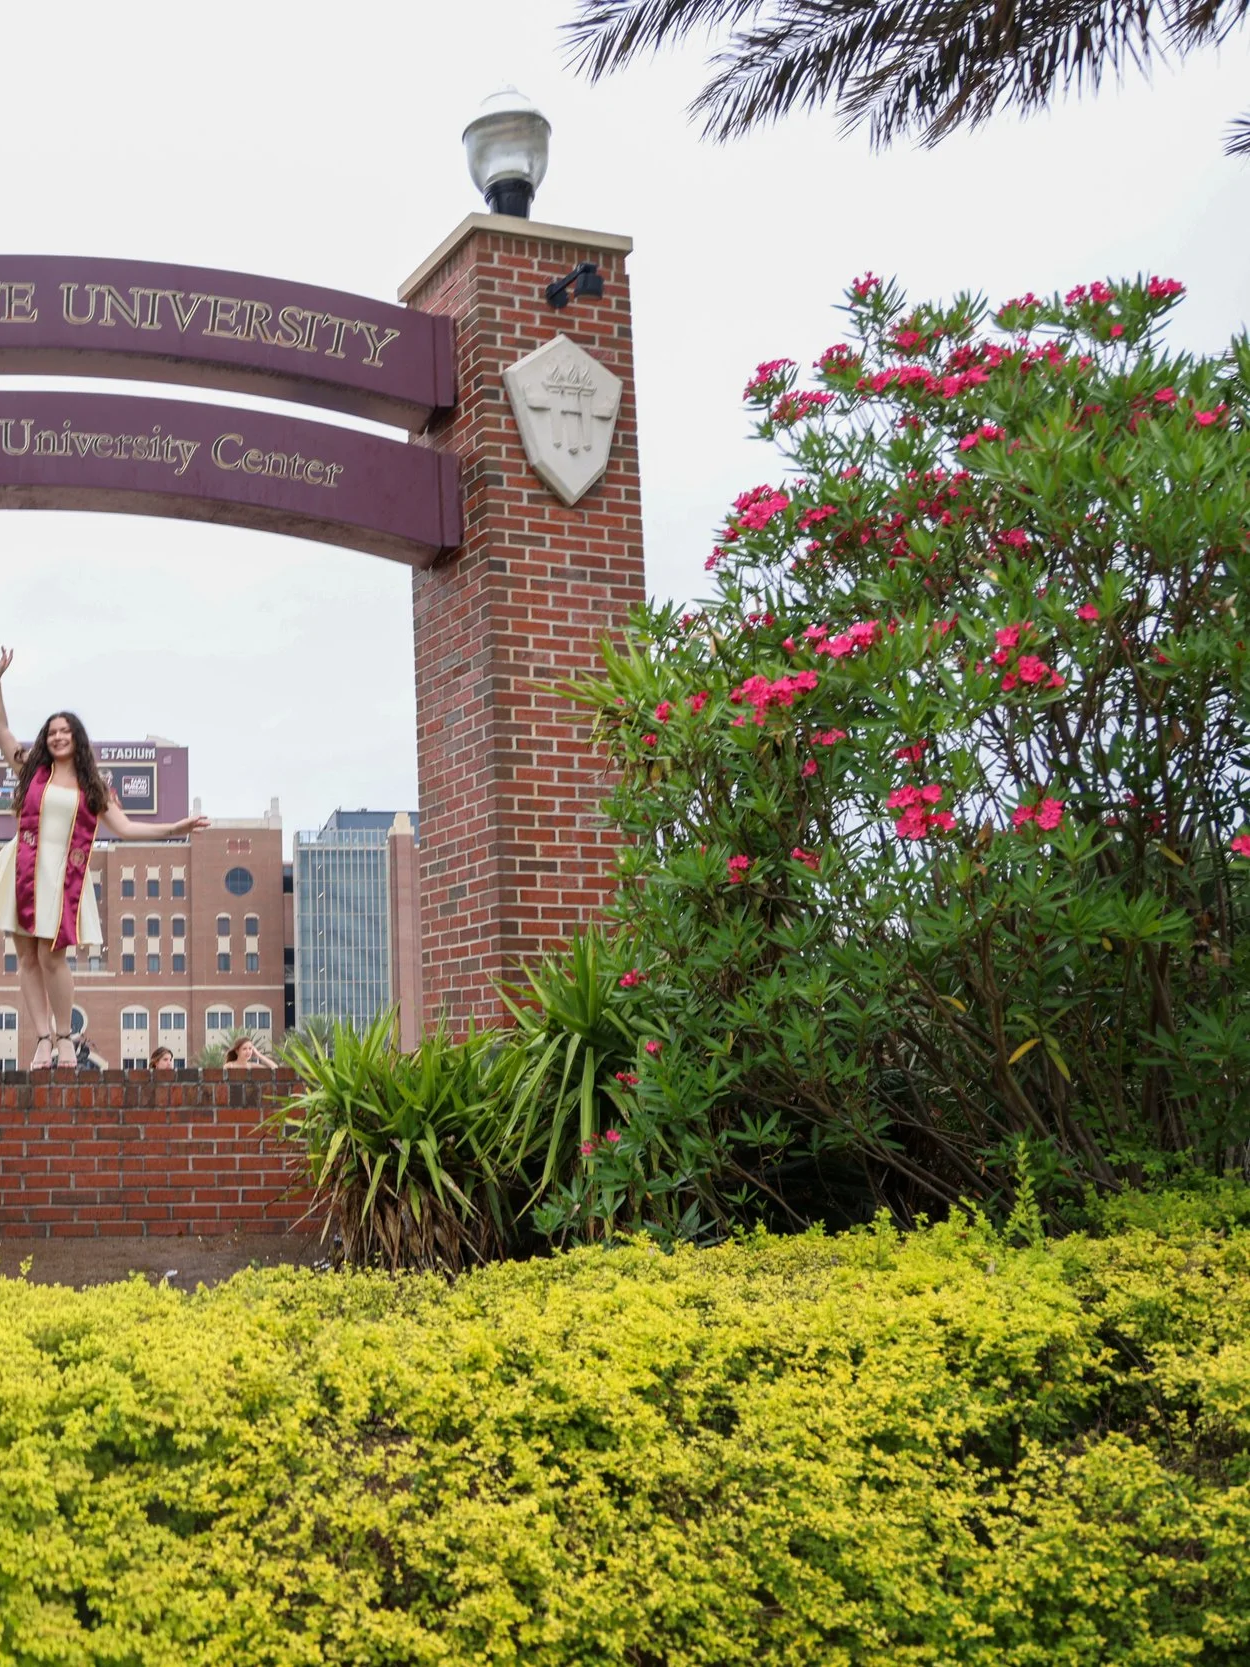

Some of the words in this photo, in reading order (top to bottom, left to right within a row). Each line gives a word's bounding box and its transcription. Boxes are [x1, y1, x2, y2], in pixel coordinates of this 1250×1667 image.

[59, 282, 400, 368] UNIVERSITY
[0, 419, 200, 476] University
[211, 433, 344, 488] Center
[101, 748, 156, 760] STADIUM
